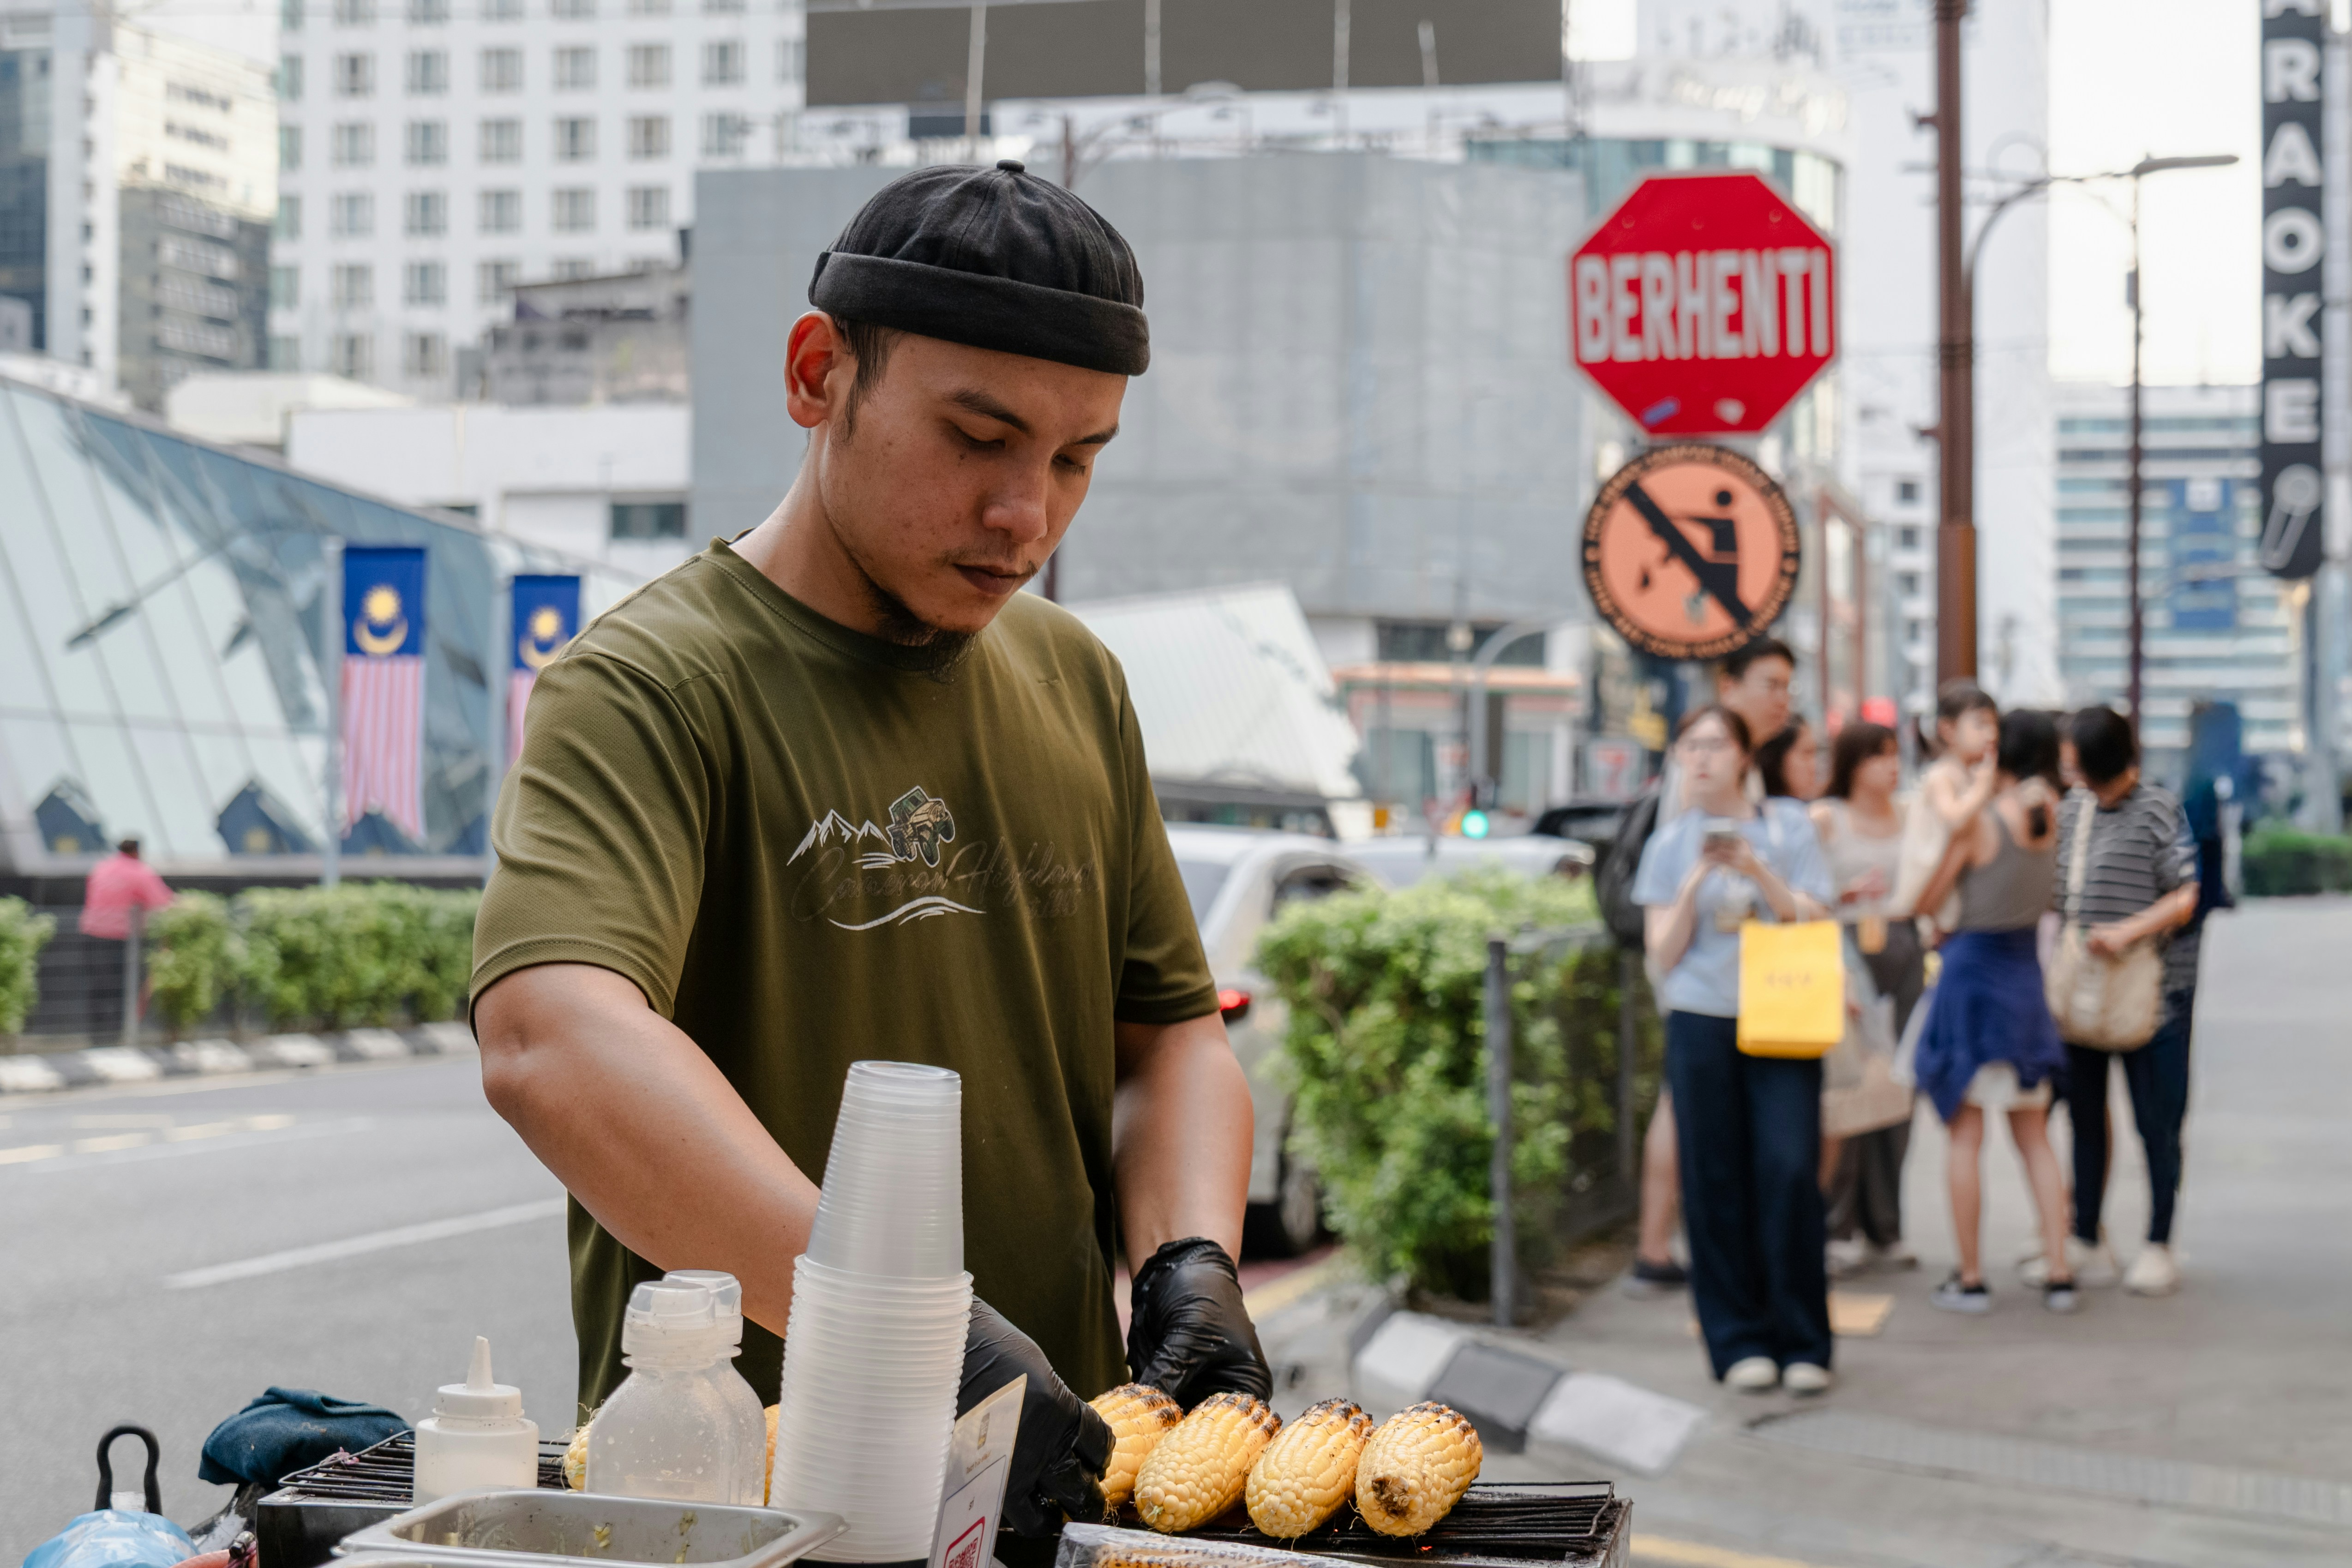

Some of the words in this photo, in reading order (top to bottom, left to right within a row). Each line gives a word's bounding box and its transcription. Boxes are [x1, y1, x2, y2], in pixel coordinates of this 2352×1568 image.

[2263, 0, 2323, 444] RAOKE
[1576, 246, 1829, 362] BERHENTI
[791, 847, 949, 922] Cameron
